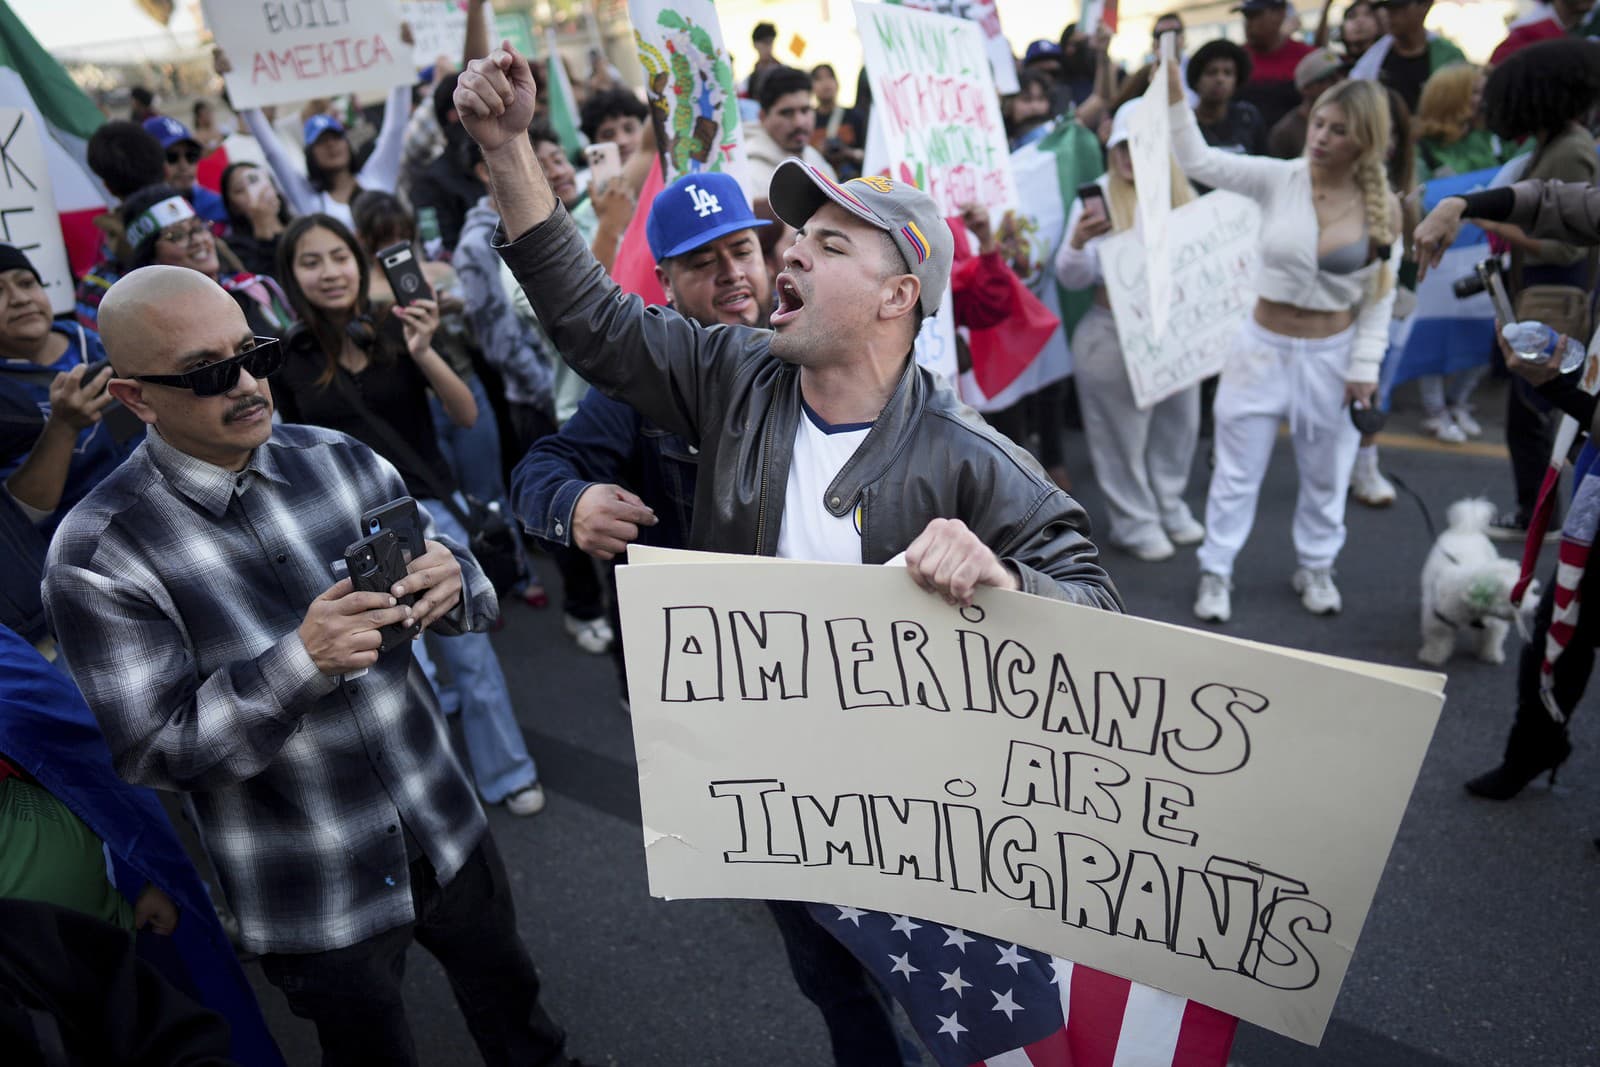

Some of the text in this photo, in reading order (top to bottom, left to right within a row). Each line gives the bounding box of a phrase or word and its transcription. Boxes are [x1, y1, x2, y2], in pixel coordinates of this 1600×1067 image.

[252, 34, 394, 85] AMERICA
[684, 183, 723, 218] LA
[1003, 740, 1199, 846] ARE
